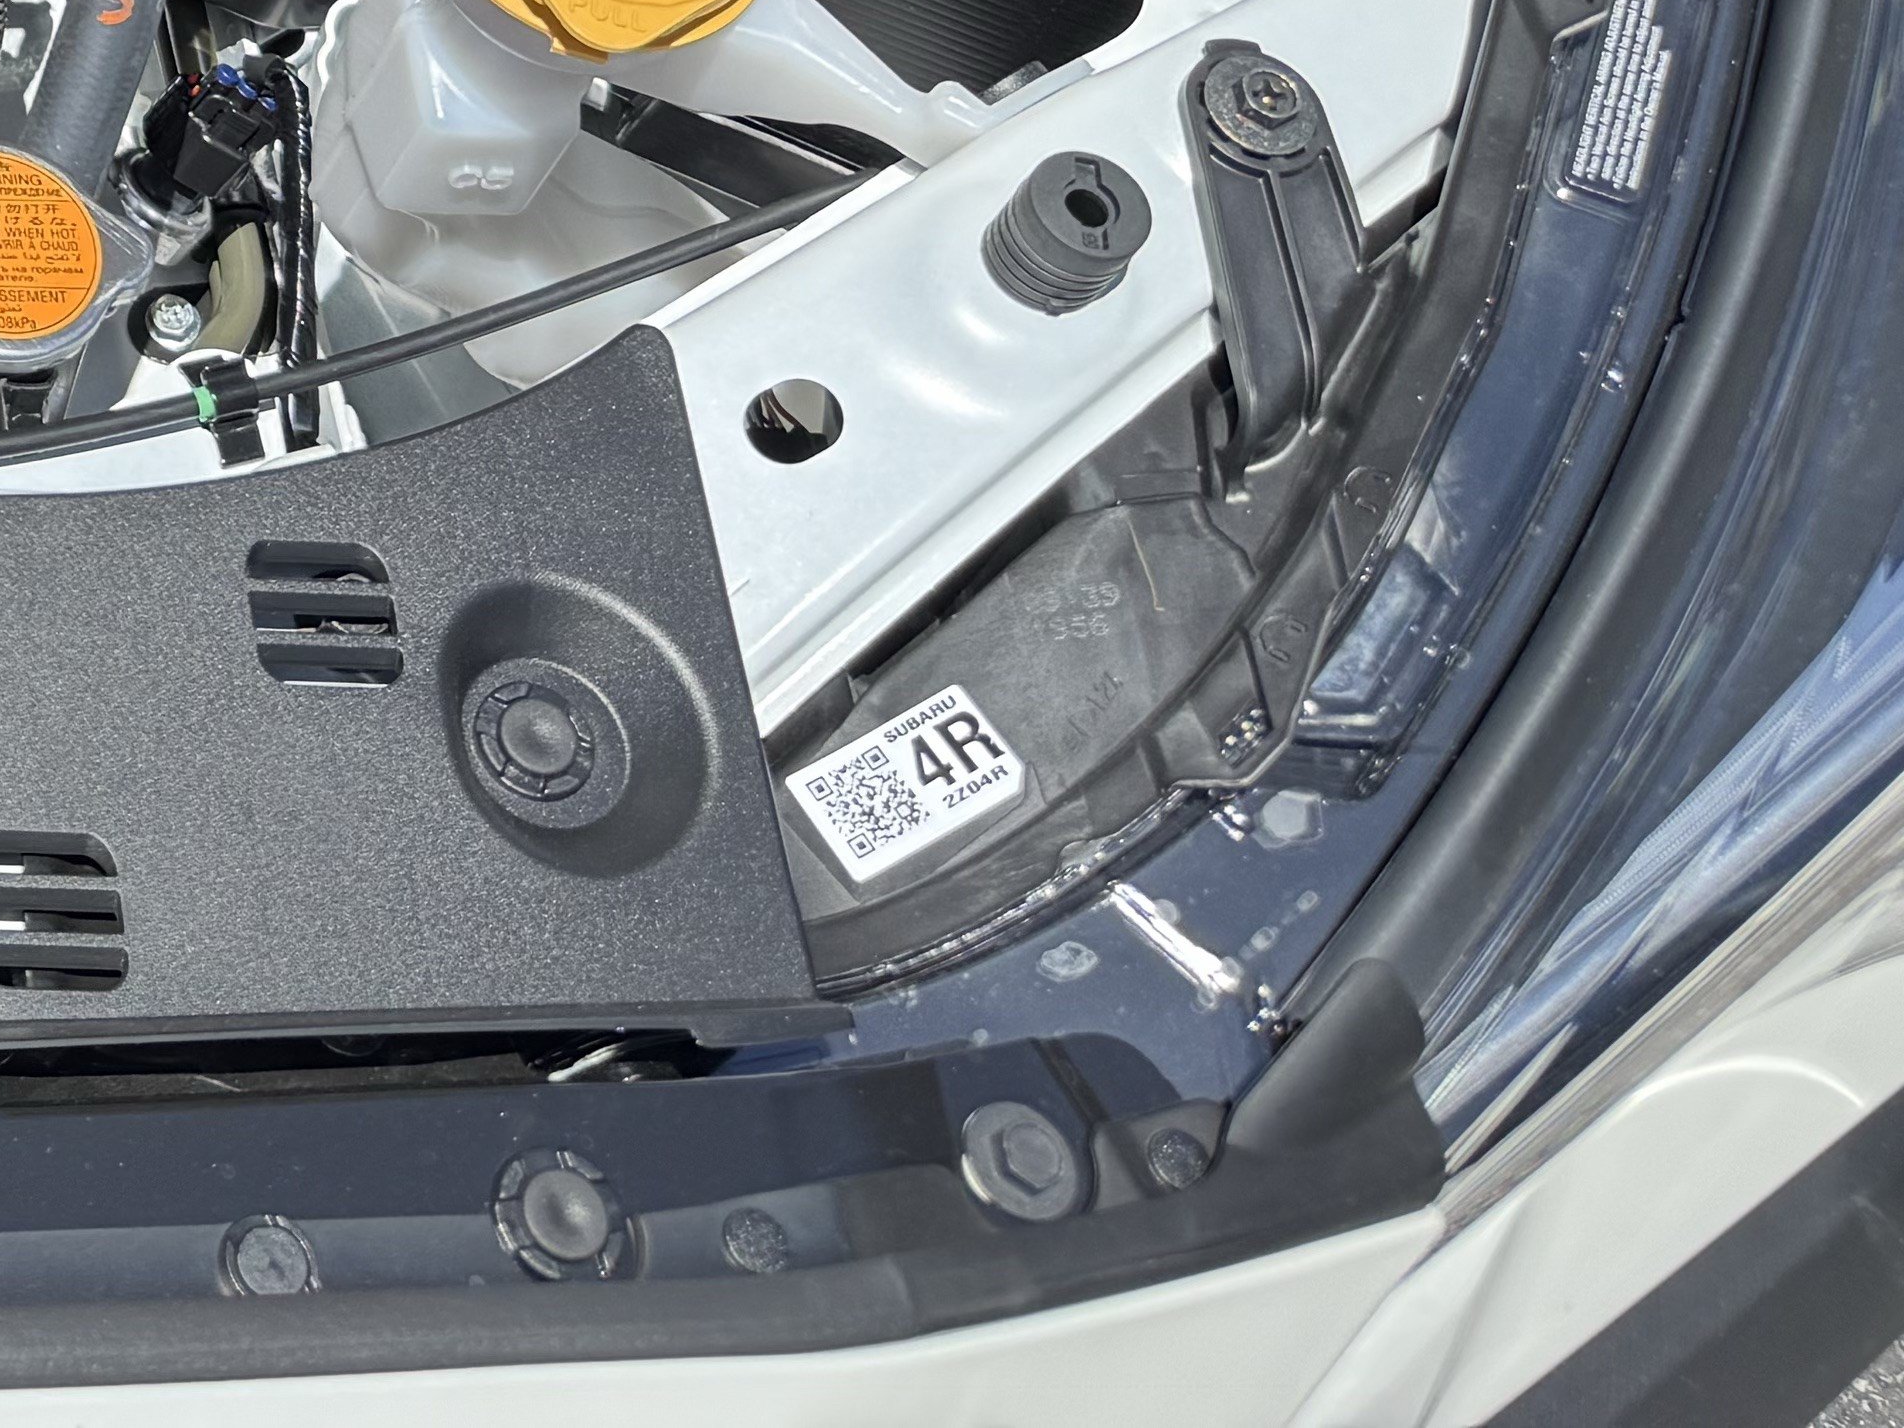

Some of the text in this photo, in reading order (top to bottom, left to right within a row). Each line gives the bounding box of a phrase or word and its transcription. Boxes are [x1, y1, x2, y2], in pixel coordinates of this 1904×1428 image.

[6, 227, 44, 238] WHEN
[884, 695, 957, 743] SUBARU
[912, 711, 1005, 786] 4R
